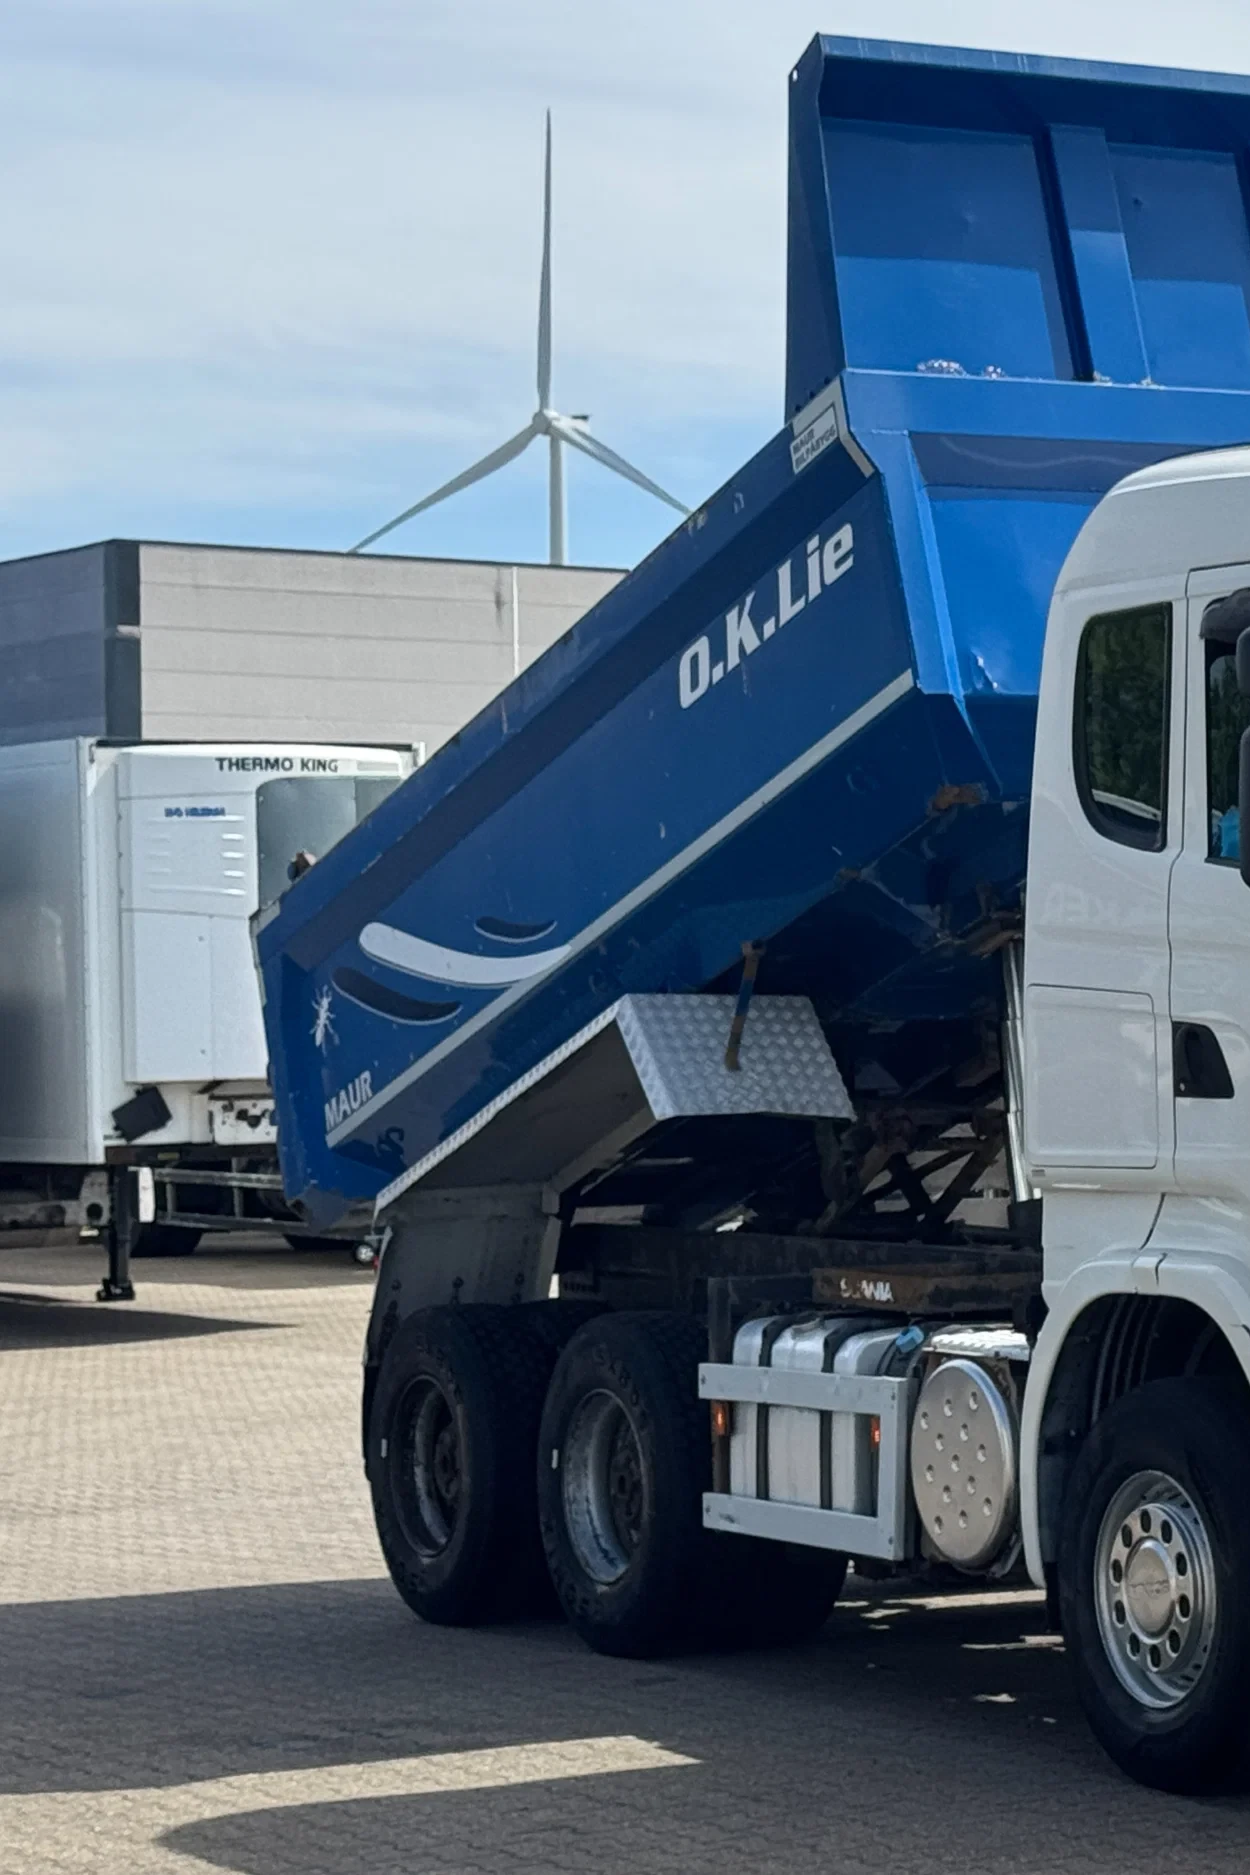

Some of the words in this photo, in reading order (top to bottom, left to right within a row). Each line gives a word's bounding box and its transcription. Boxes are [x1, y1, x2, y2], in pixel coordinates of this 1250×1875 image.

[679, 523, 854, 709] O.K.Lie
[215, 757, 293, 772] THERMO
[300, 758, 338, 773] KING
[324, 1070, 373, 1132] MAUR
